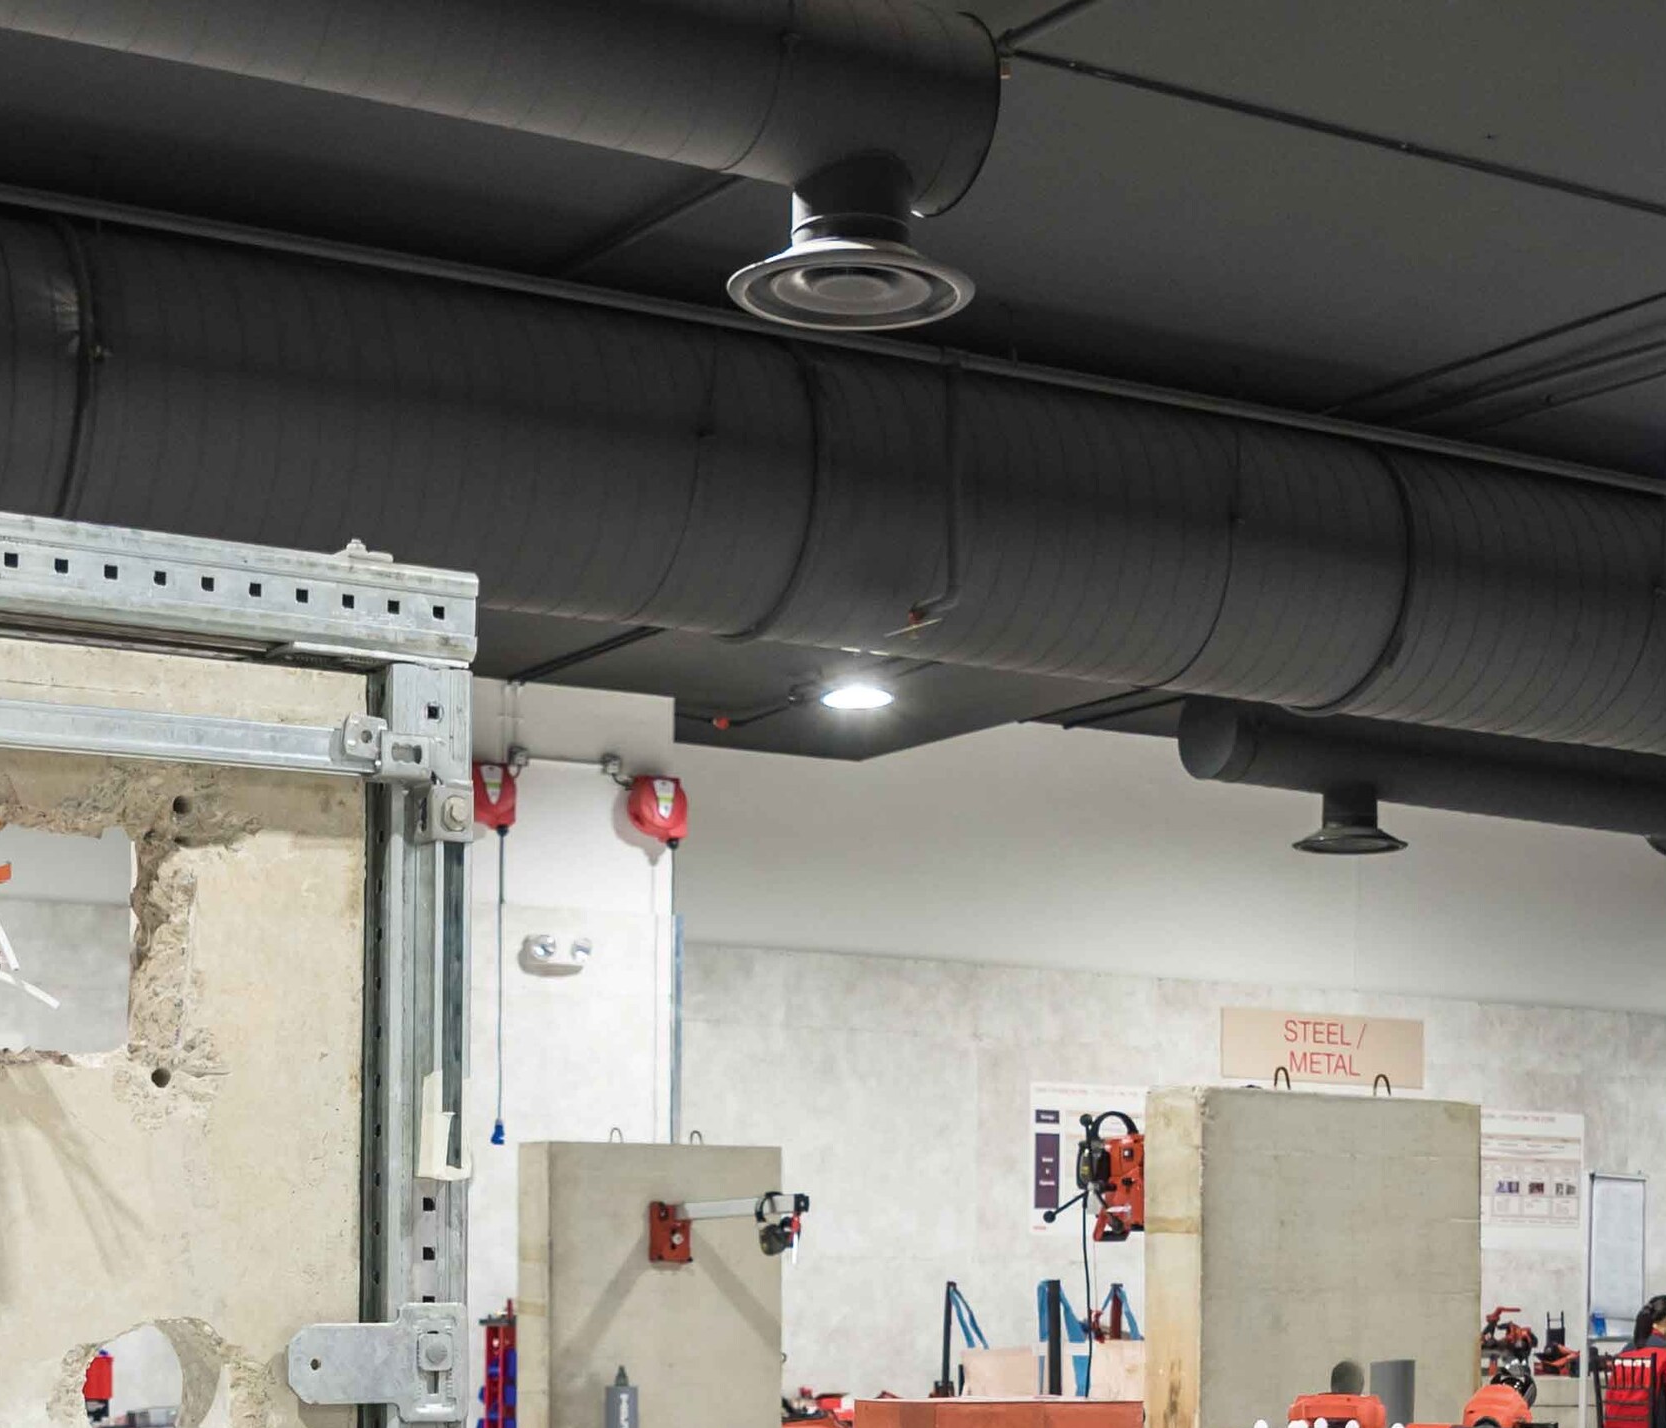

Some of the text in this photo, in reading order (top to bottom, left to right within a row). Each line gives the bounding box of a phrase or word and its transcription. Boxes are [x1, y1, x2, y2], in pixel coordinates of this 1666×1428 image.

[1284, 1019, 1367, 1050] STEEL /
[1289, 1050, 1361, 1077] METAL
